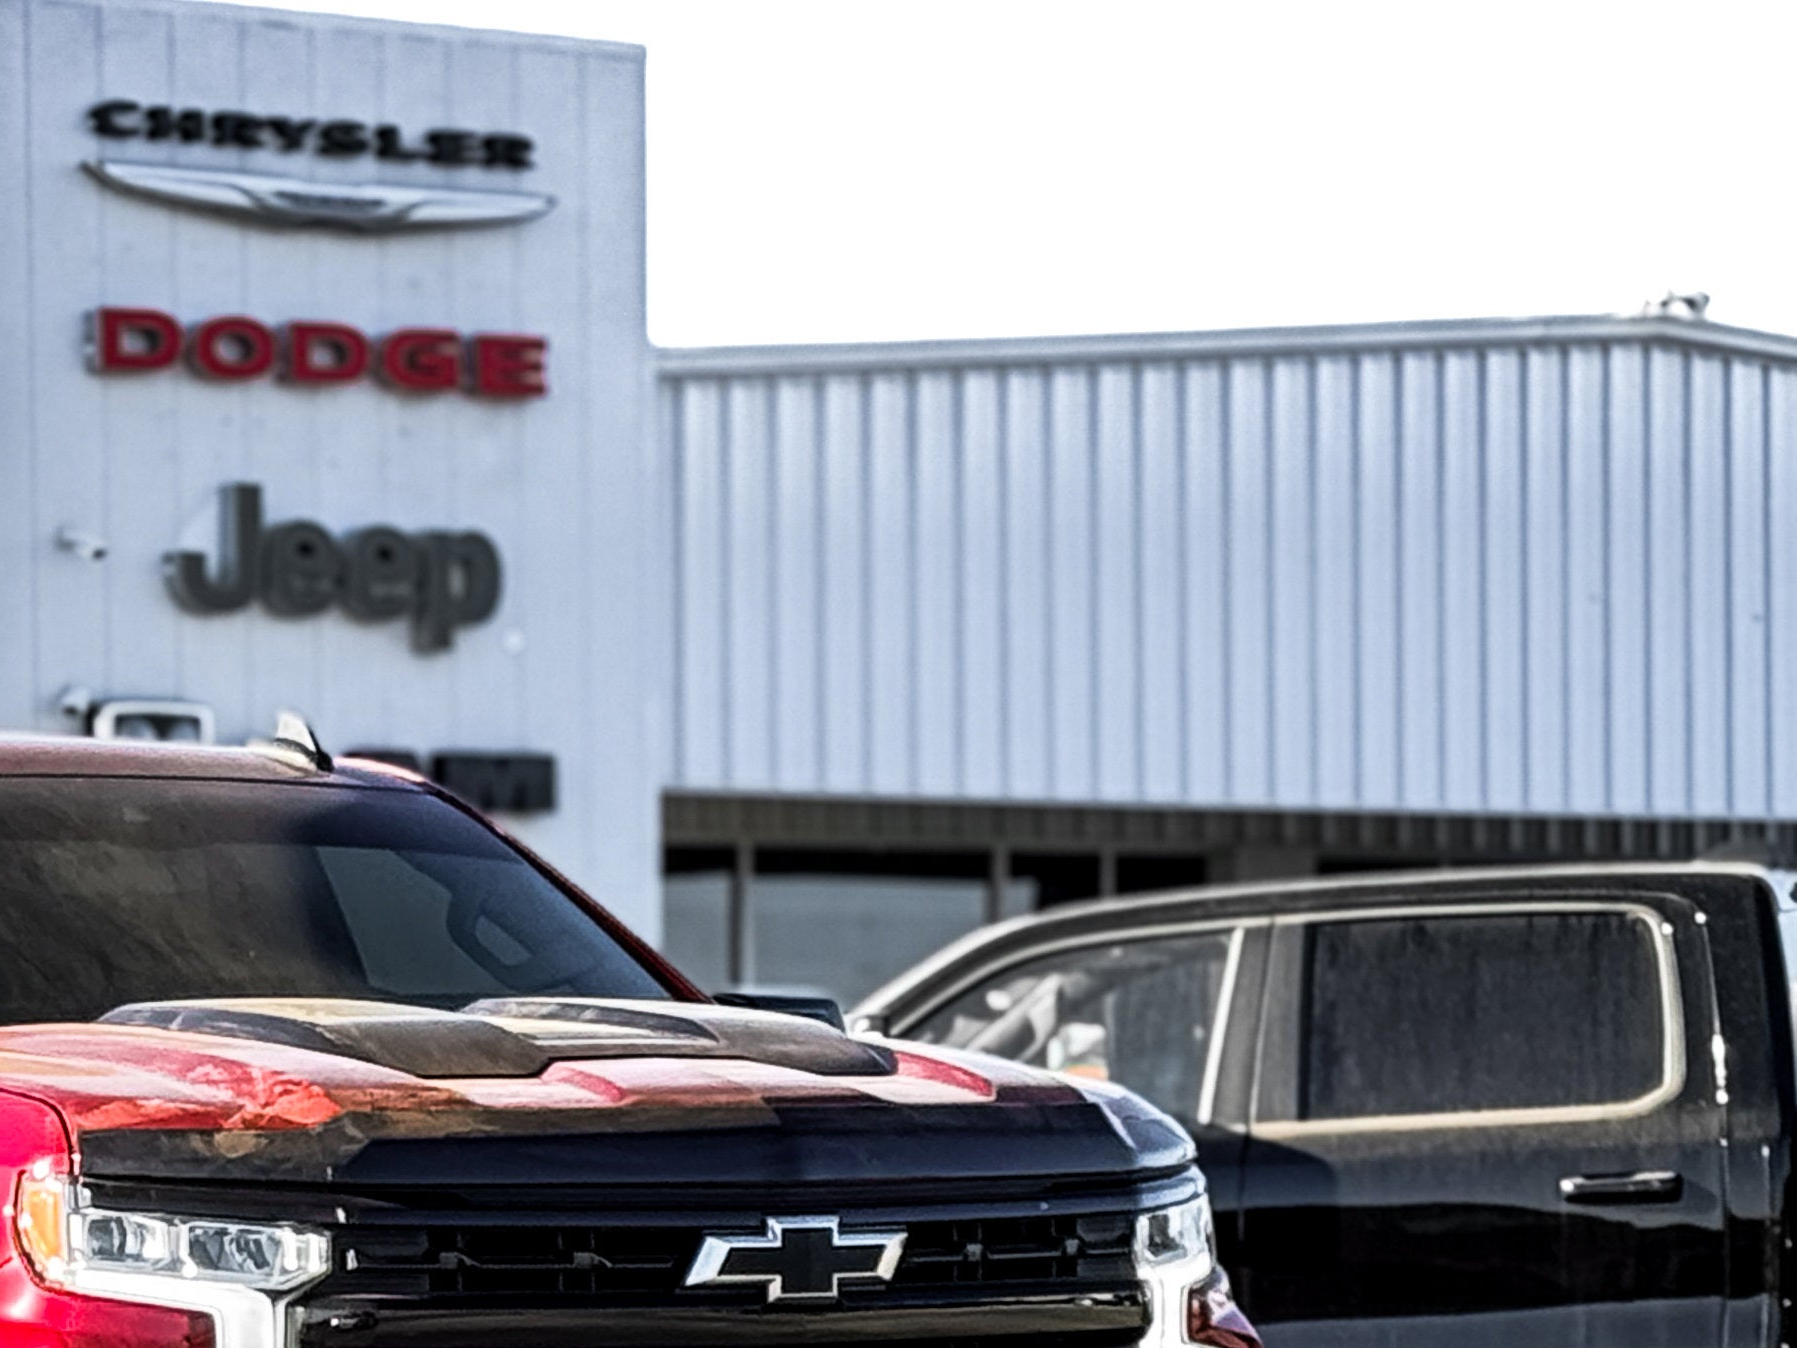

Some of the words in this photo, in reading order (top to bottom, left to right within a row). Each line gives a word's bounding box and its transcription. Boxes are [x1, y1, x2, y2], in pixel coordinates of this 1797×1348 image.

[88, 98, 536, 170] CHRYSLER
[86, 306, 549, 398] DODGE
[162, 481, 503, 656] Jeep
